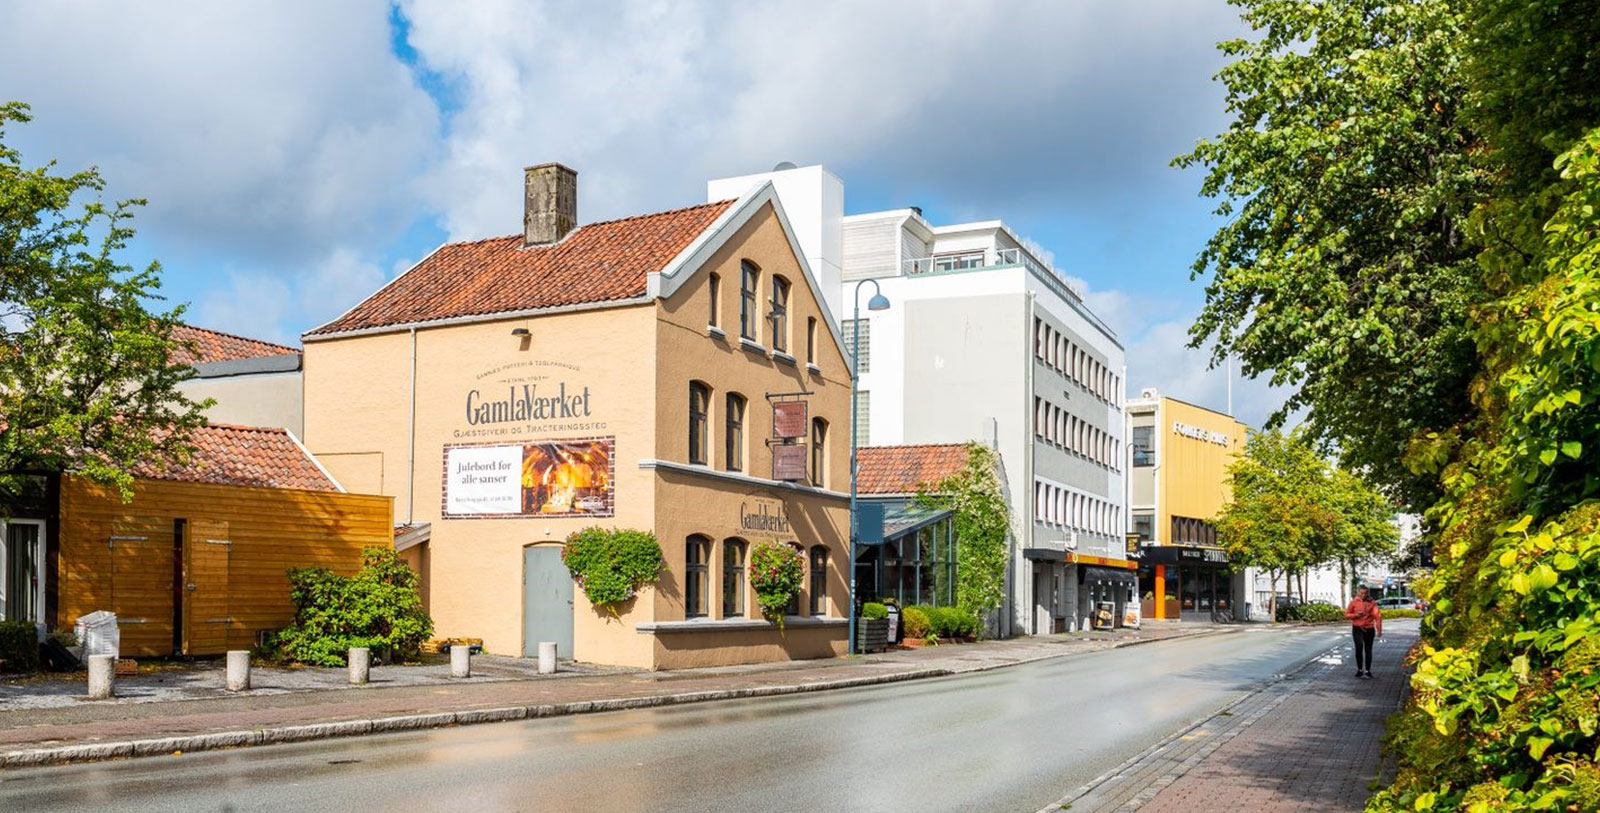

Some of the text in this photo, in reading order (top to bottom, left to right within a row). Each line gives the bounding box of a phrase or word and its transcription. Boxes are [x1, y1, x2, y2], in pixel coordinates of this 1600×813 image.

[466, 382, 592, 426] GamlaVærket
[453, 428, 508, 438] GJÆSTGIVERI
[511, 426, 522, 434] OG
[456, 460, 512, 474] Julebord for
[462, 474, 508, 484] alle sanser
